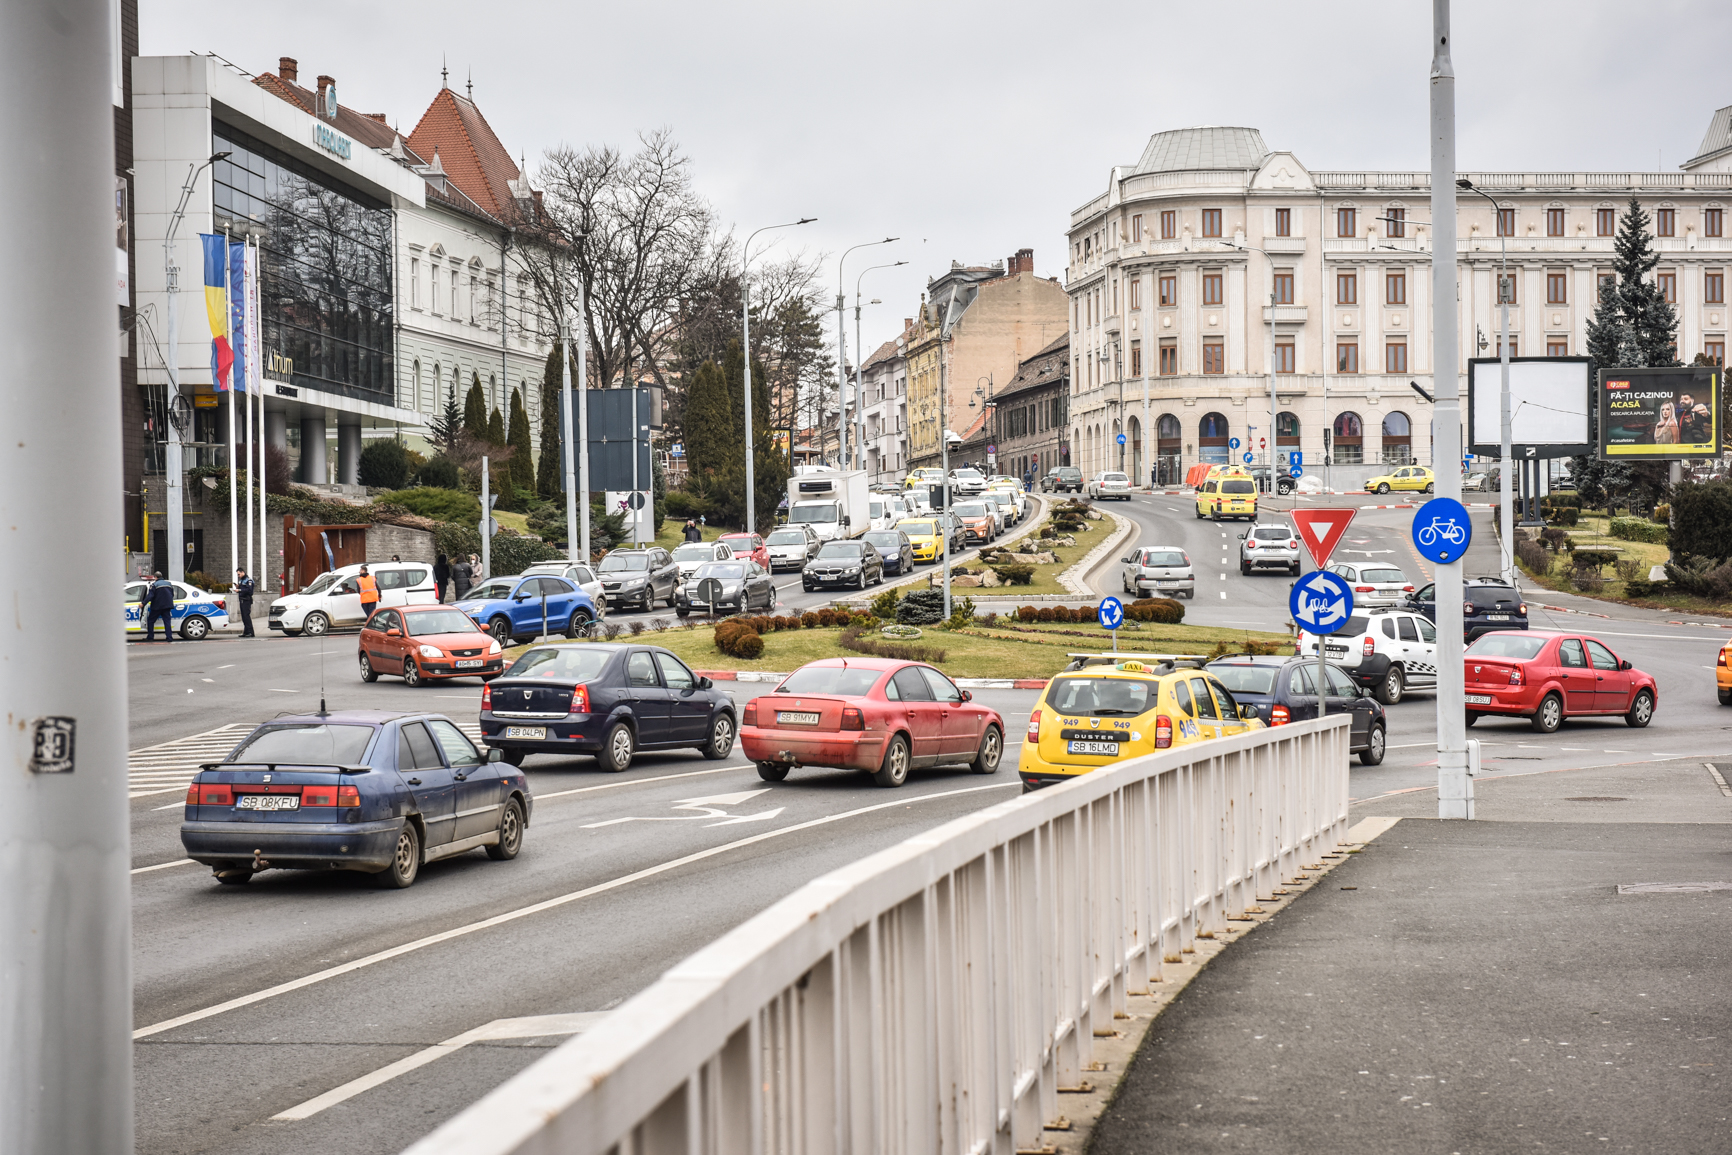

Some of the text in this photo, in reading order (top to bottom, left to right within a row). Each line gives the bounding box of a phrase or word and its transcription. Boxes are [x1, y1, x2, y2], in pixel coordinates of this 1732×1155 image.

[1634, 391, 1673, 399] CAZINOU
[1610, 400, 1641, 409] ACASĂ
[1124, 663, 1142, 671] TAXI
[781, 713, 816, 723] SB 91MYA
[1063, 718, 1079, 726] 949
[1113, 721, 1130, 729] 949
[1179, 718, 1199, 739] 949
[511, 728, 544, 737] SB 04LPN
[1074, 733, 1114, 741] DUSTER
[1073, 742, 1117, 753] SB 16LMD
[242, 797, 298, 808] SB 08KFU
